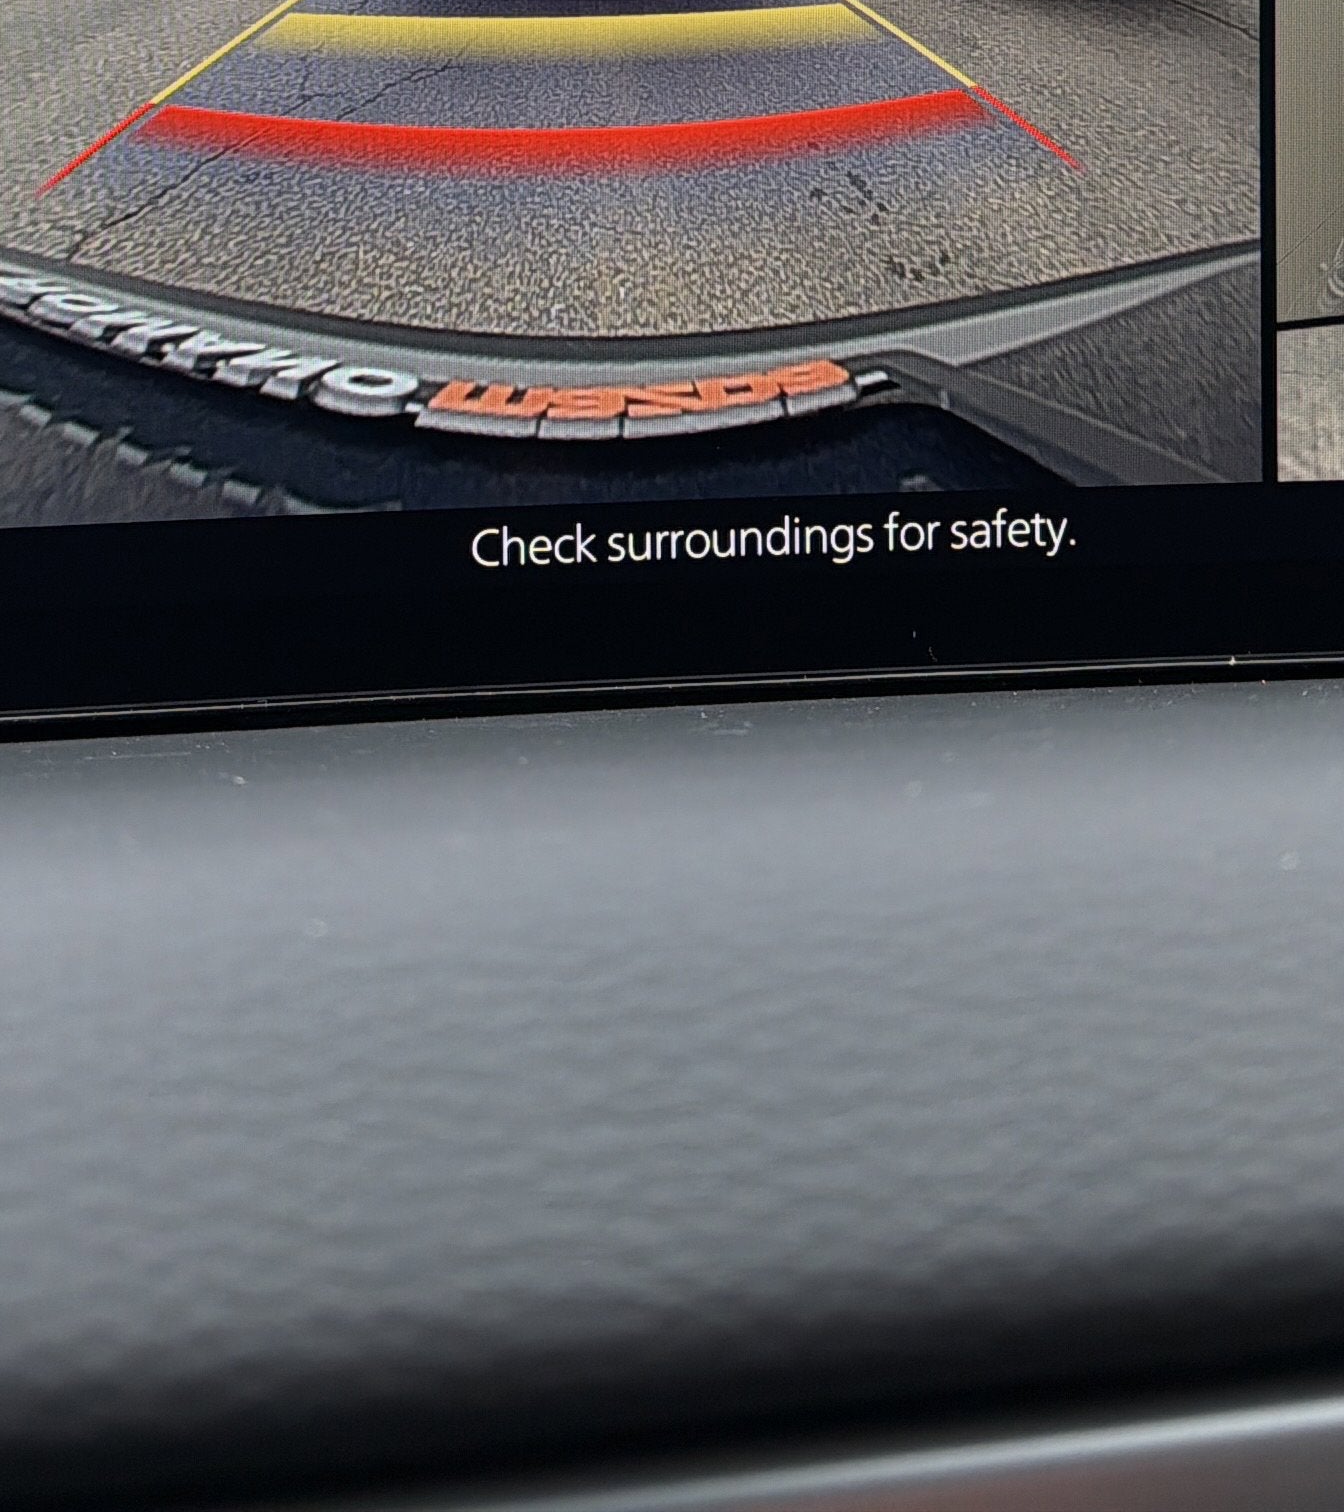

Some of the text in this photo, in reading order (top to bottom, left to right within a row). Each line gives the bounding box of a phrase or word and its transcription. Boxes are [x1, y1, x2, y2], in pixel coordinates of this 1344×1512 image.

[471, 507, 1076, 567] Check surroundings for safety.
